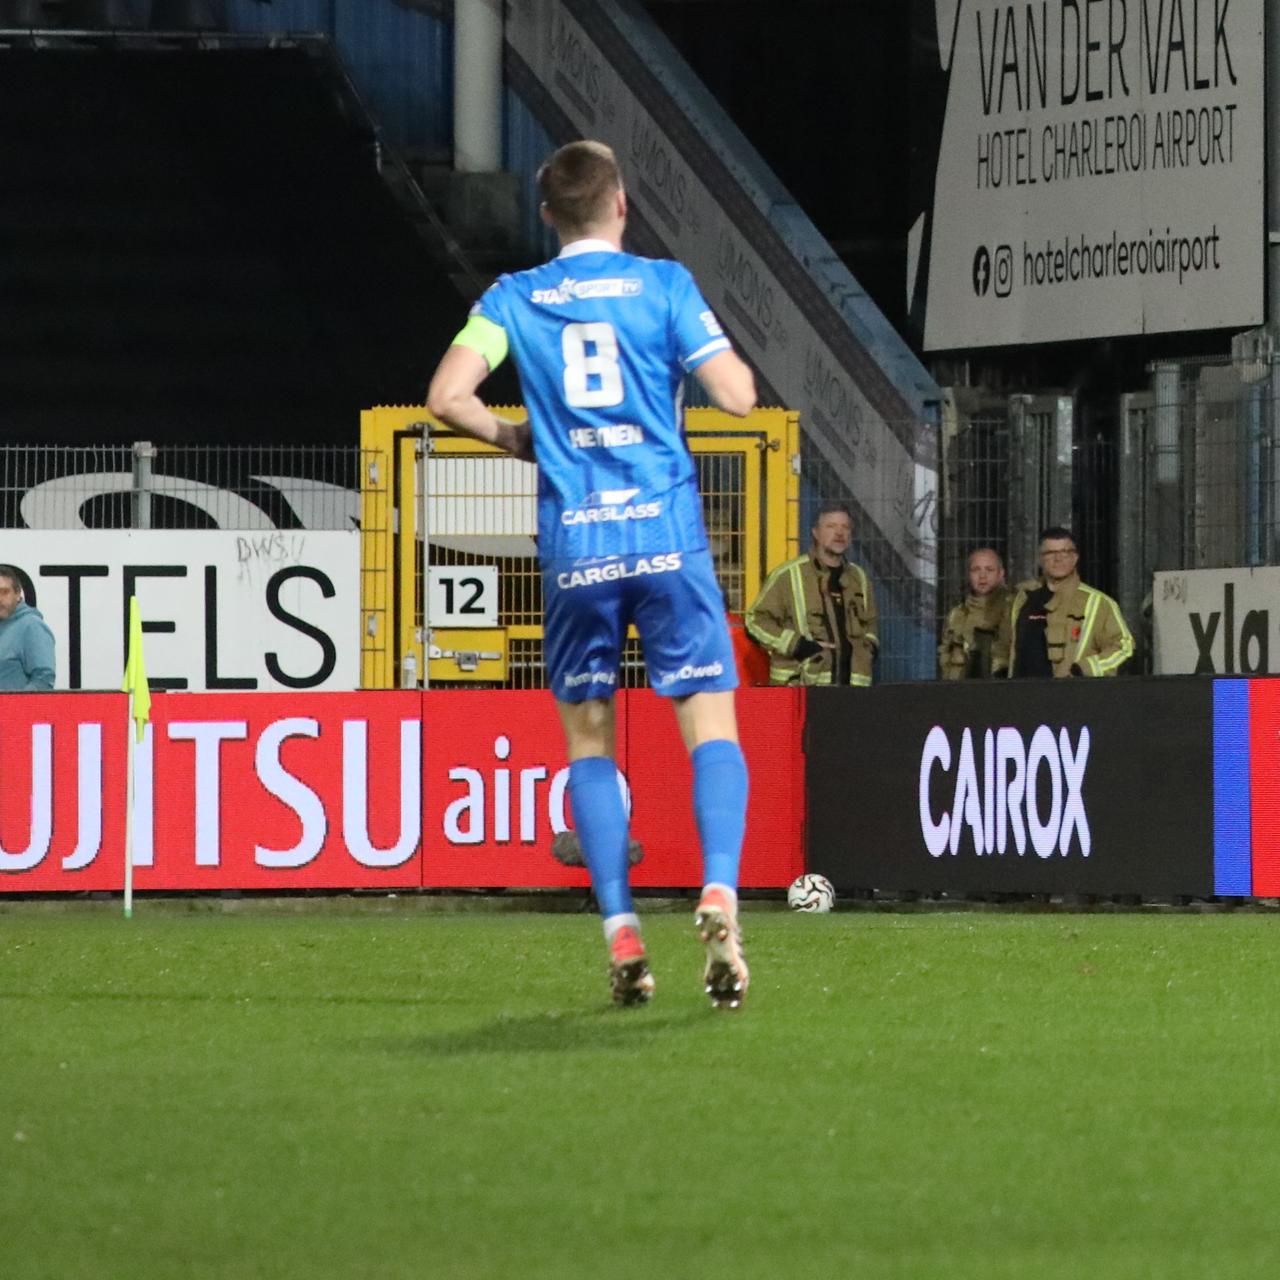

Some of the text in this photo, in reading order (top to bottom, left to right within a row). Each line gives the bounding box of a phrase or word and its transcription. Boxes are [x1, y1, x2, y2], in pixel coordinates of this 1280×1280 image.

[976, 1, 1048, 116] VAN
[976, 104, 1238, 189] HOTEL CHARLEROI AIRPORT
[1022, 225, 1221, 287] hotelcharleroiairport
[562, 322, 624, 408] 8
[569, 424, 644, 450] HEYNEN
[561, 501, 661, 525] CARGLASS
[438, 577, 486, 615] 12
[557, 552, 682, 590] CARGLASS
[919, 724, 1092, 859] CAIROX
